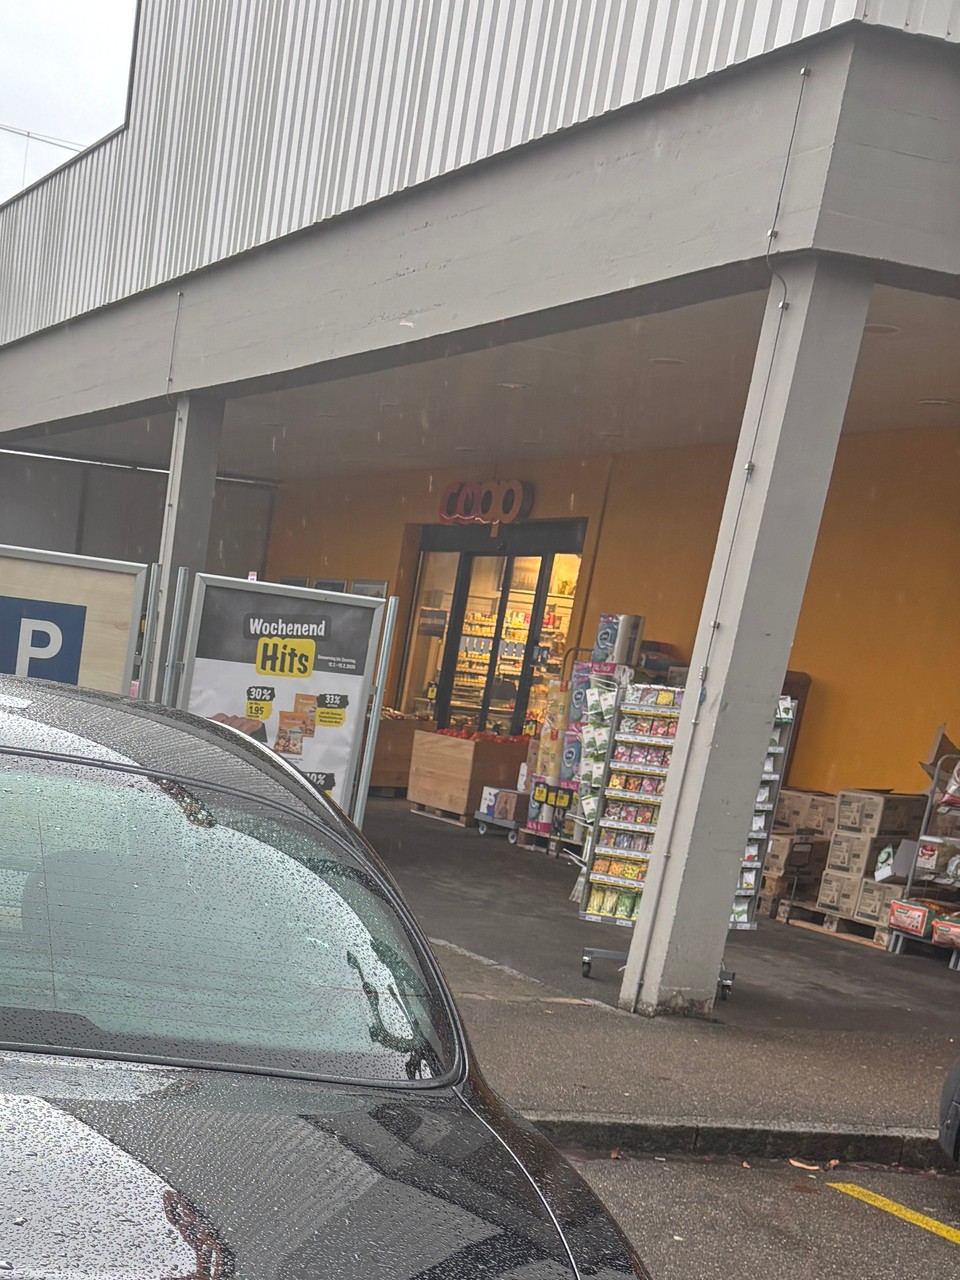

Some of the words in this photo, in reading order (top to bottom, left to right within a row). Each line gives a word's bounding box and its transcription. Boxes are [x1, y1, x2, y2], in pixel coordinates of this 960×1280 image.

[439, 480, 524, 538] coop
[249, 618, 325, 636] Wochenend
[15, 618, 63, 677] P
[260, 643, 309, 674] Hits
[249, 688, 272, 700] 30%
[325, 694, 341, 704] 33%
